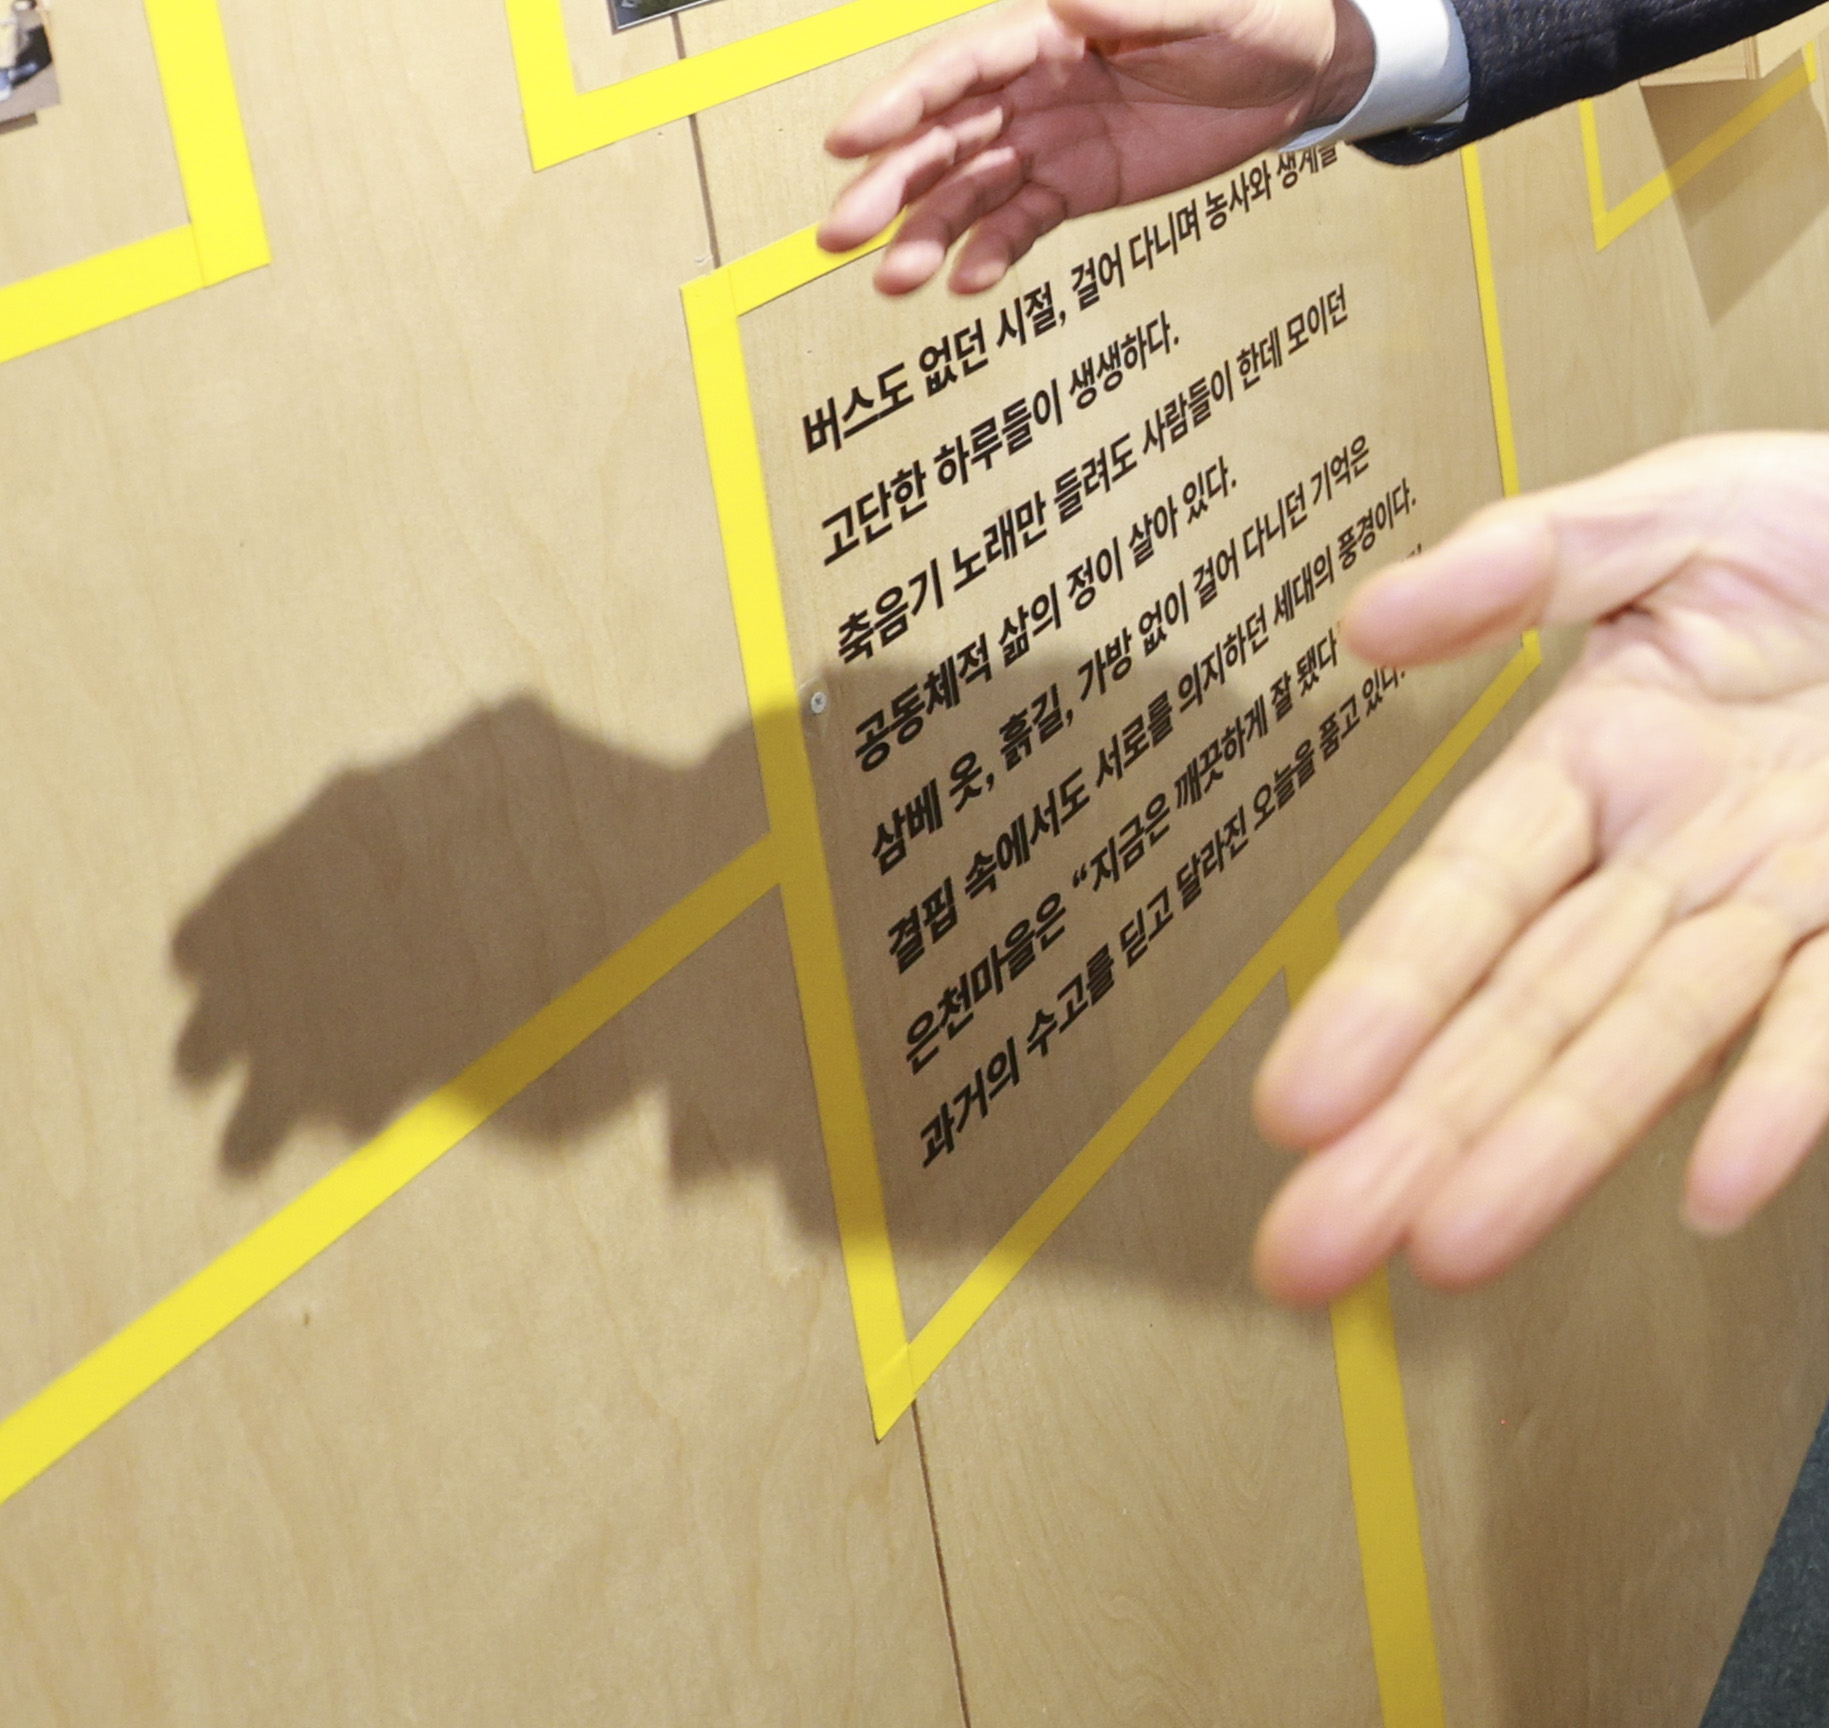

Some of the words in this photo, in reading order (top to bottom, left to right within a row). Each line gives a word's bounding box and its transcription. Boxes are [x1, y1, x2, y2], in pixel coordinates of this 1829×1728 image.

[802, 362, 914, 455] 버스도
[918, 319, 989, 398] 없던
[995, 281, 1067, 349] 시절,
[1070, 242, 1126, 312] 걸어
[1127, 198, 1202, 271] 다니며
[1204, 159, 1273, 232] 농사와
[821, 459, 928, 567] 고단한
[933, 378, 1063, 486] 하루들이
[1068, 309, 1180, 410] 생생하다.
[837, 557, 945, 665] 축음기
[951, 490, 1048, 593] 노래만
[1053, 432, 1138, 525] 들려도
[1142, 360, 1234, 455] 사람들이
[1236, 326, 1283, 392] 한데
[1286, 282, 1349, 357] 모이던
[854, 631, 993, 773] 공동체적
[998, 581, 1062, 669] 삶의
[1065, 535, 1125, 612] 정이
[1127, 494, 1179, 569] 살아
[1181, 454, 1237, 525] 있다.
[871, 777, 944, 876] 삼베
[948, 750, 995, 813] 옷,
[998, 682, 1074, 772] 흙길,
[1076, 626, 1133, 702] 가방
[1138, 580, 1190, 658] 없이
[1192, 537, 1241, 610] 걸어
[1241, 481, 1309, 561] 다니던
[1309, 434, 1370, 507] 기억은
[887, 875, 959, 975] 결핍
[963, 767, 1091, 901] 속에서도
[1095, 690, 1174, 790] 서로를
[1177, 604, 1270, 714] 의지하던
[1273, 543, 1335, 624] 세대의
[1336, 476, 1418, 572] 풍경이다.
[905, 892, 1067, 1076] 은천마을은
[1072, 793, 1171, 893] “지금은
[1174, 696, 1269, 811] 깨끗하게
[1271, 670, 1294, 723] 잘
[920, 1035, 1020, 1169] 과거의
[1026, 942, 1116, 1058] 수고를
[1119, 885, 1174, 970] 딛고
[1176, 805, 1250, 911] 달라진
[1252, 739, 1316, 832] 오늘을
[1318, 692, 1361, 763] 품고
